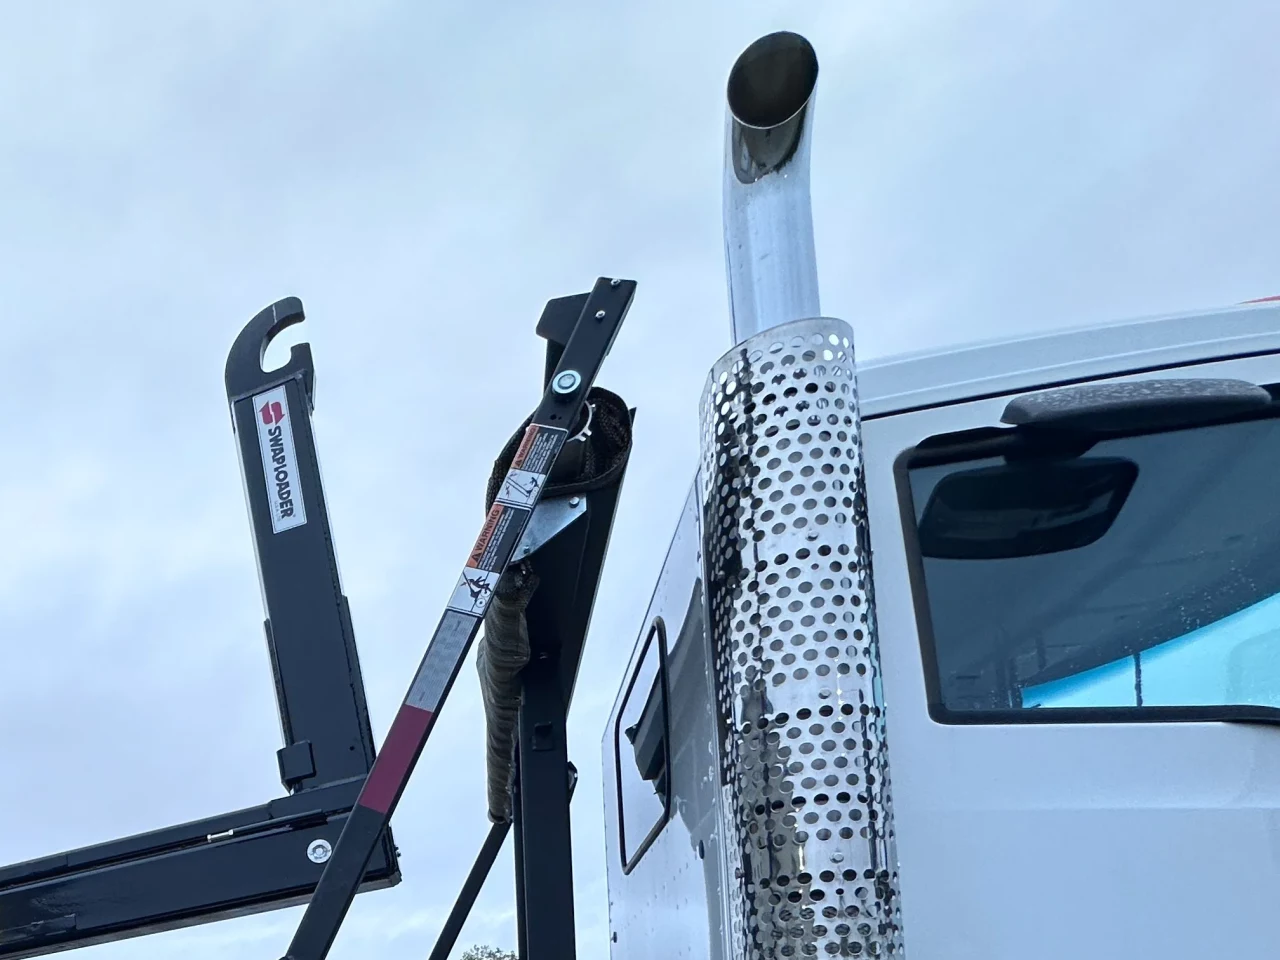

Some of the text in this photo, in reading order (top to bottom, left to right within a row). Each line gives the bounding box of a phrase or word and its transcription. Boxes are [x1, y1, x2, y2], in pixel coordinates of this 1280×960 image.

[518, 427, 536, 459] WARNING
[268, 425, 294, 519] SWAPLOADER
[476, 509, 500, 553] WARNING
